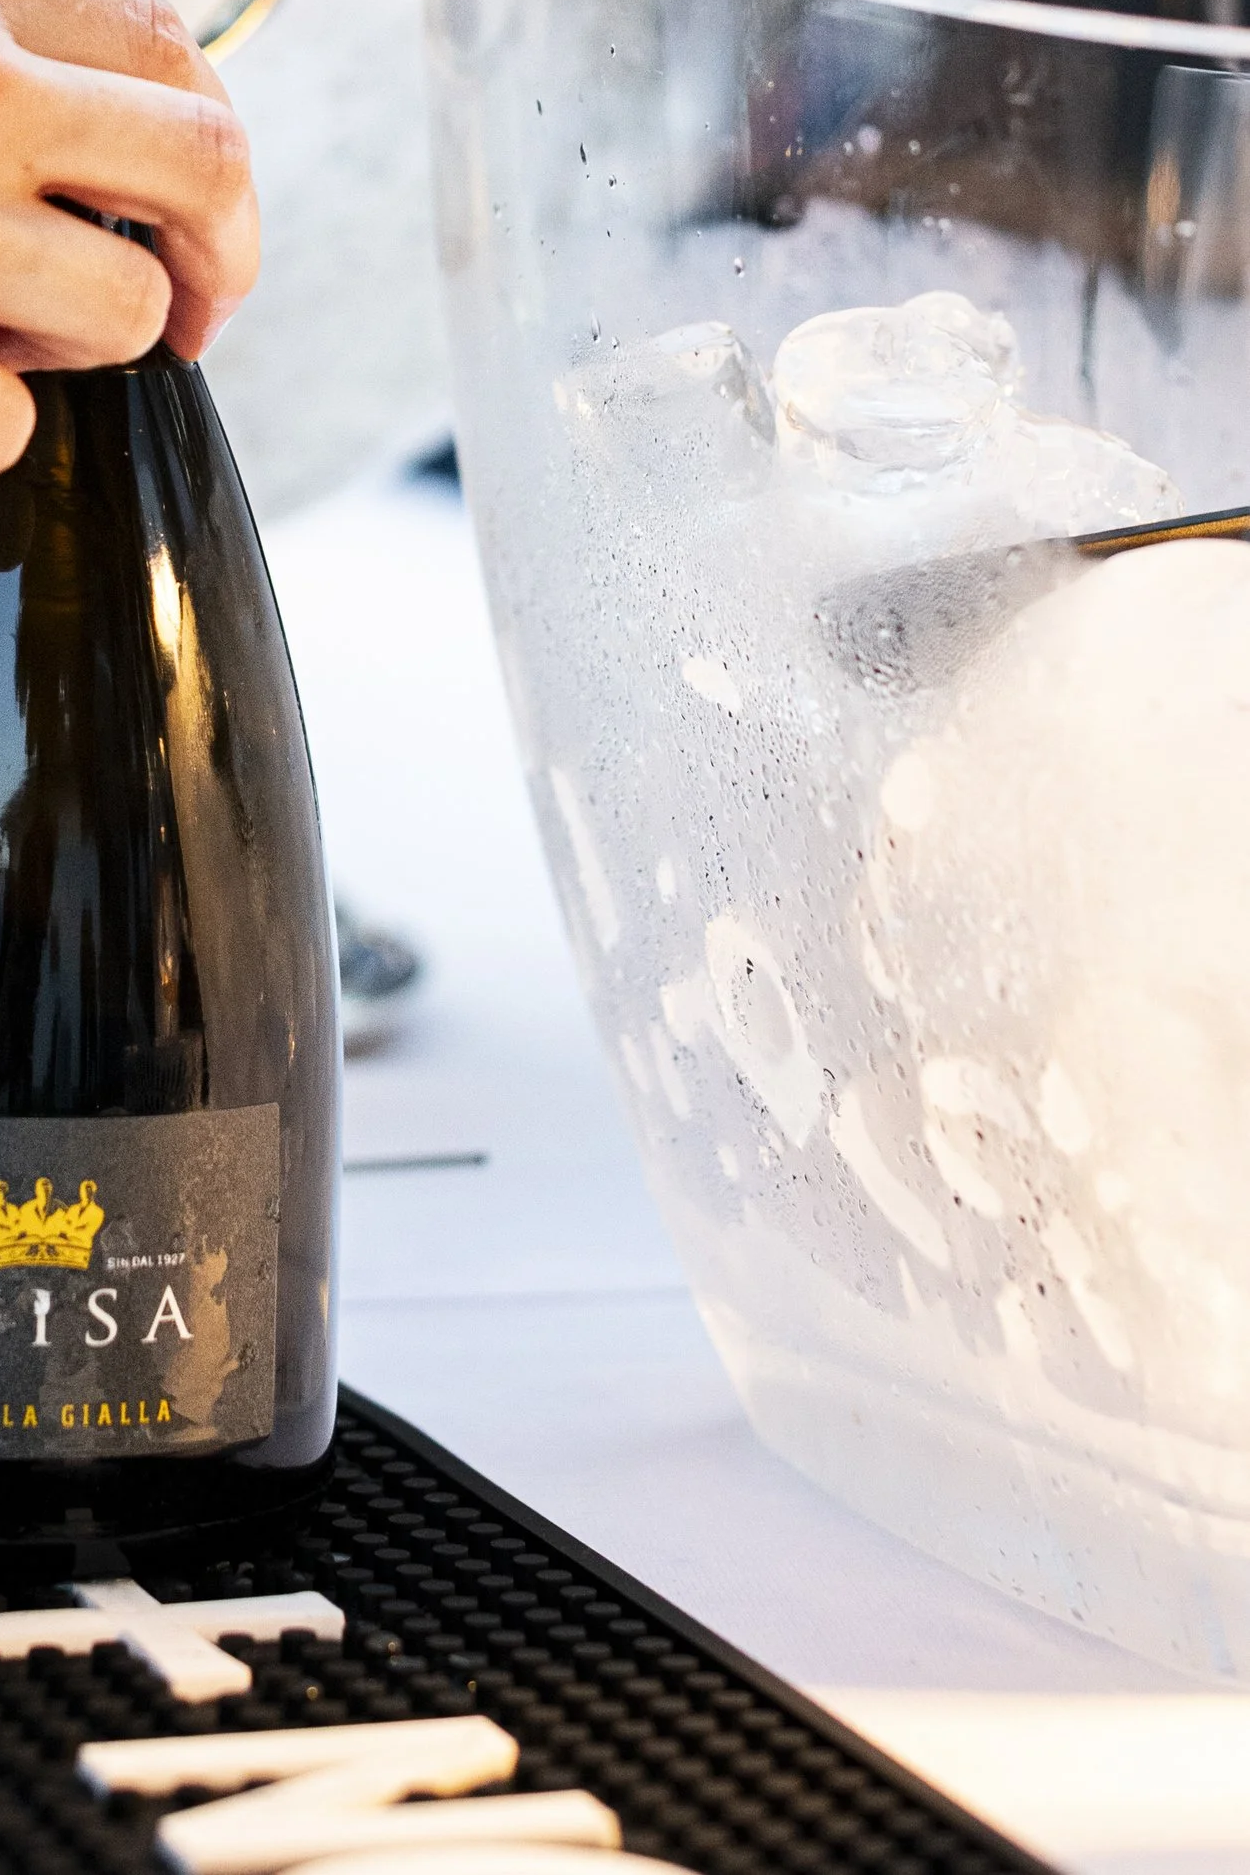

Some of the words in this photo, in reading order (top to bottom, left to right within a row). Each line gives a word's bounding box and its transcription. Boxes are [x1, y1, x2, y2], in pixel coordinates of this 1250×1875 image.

[107, 1256, 129, 1269] SIN
[131, 1255, 154, 1267] DAL
[157, 1252, 185, 1266] 1927
[61, 1398, 171, 1427] GIALLA
